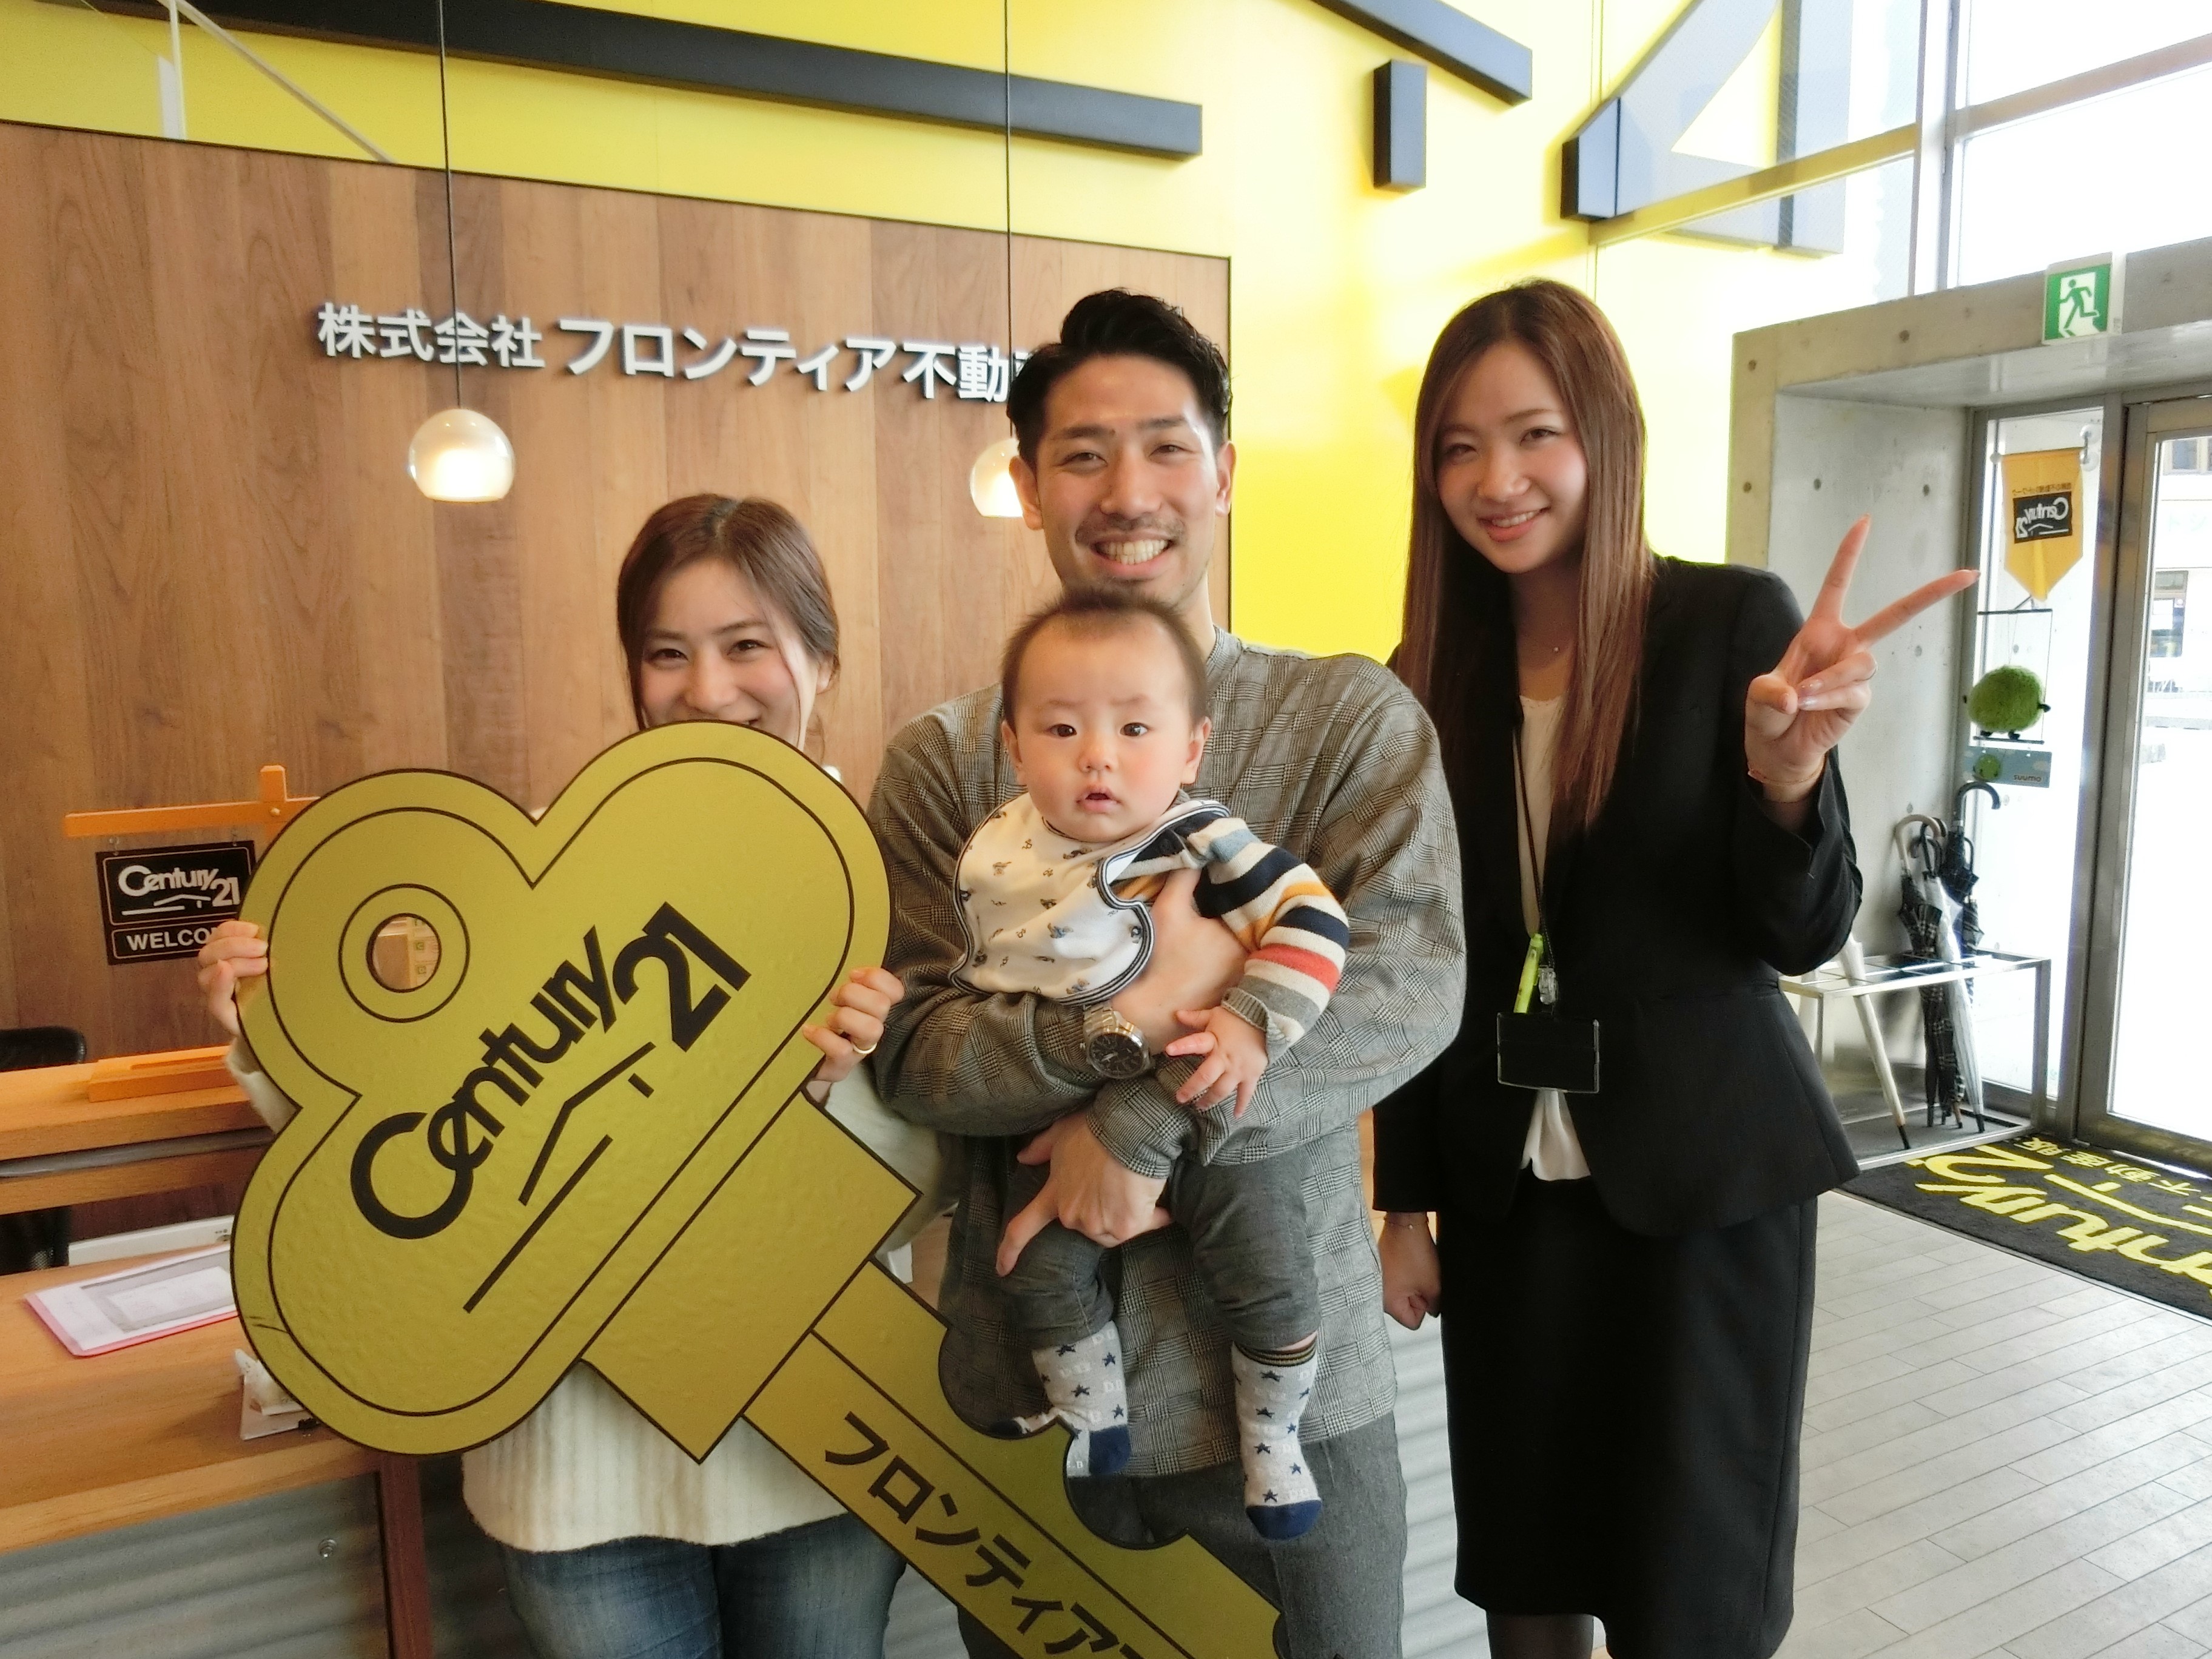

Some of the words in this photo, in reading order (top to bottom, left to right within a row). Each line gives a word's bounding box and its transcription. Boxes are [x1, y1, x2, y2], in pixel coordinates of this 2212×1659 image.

[318, 302, 545, 368] 株式会社
[559, 317, 1032, 403] フロンティア不動
[2013, 774, 2042, 782] suumo
[118, 865, 219, 897] Century
[212, 877, 240, 907] 21
[126, 927, 218, 951] WELCO
[350, 924, 617, 1239] Century
[612, 901, 751, 1052] 21
[1904, 1145, 2054, 1183] 2
[2003, 1136, 2212, 1201] 不動産販
[1915, 1183, 2212, 1285] ntury
[825, 1411, 1146, 1659] フロンティア
